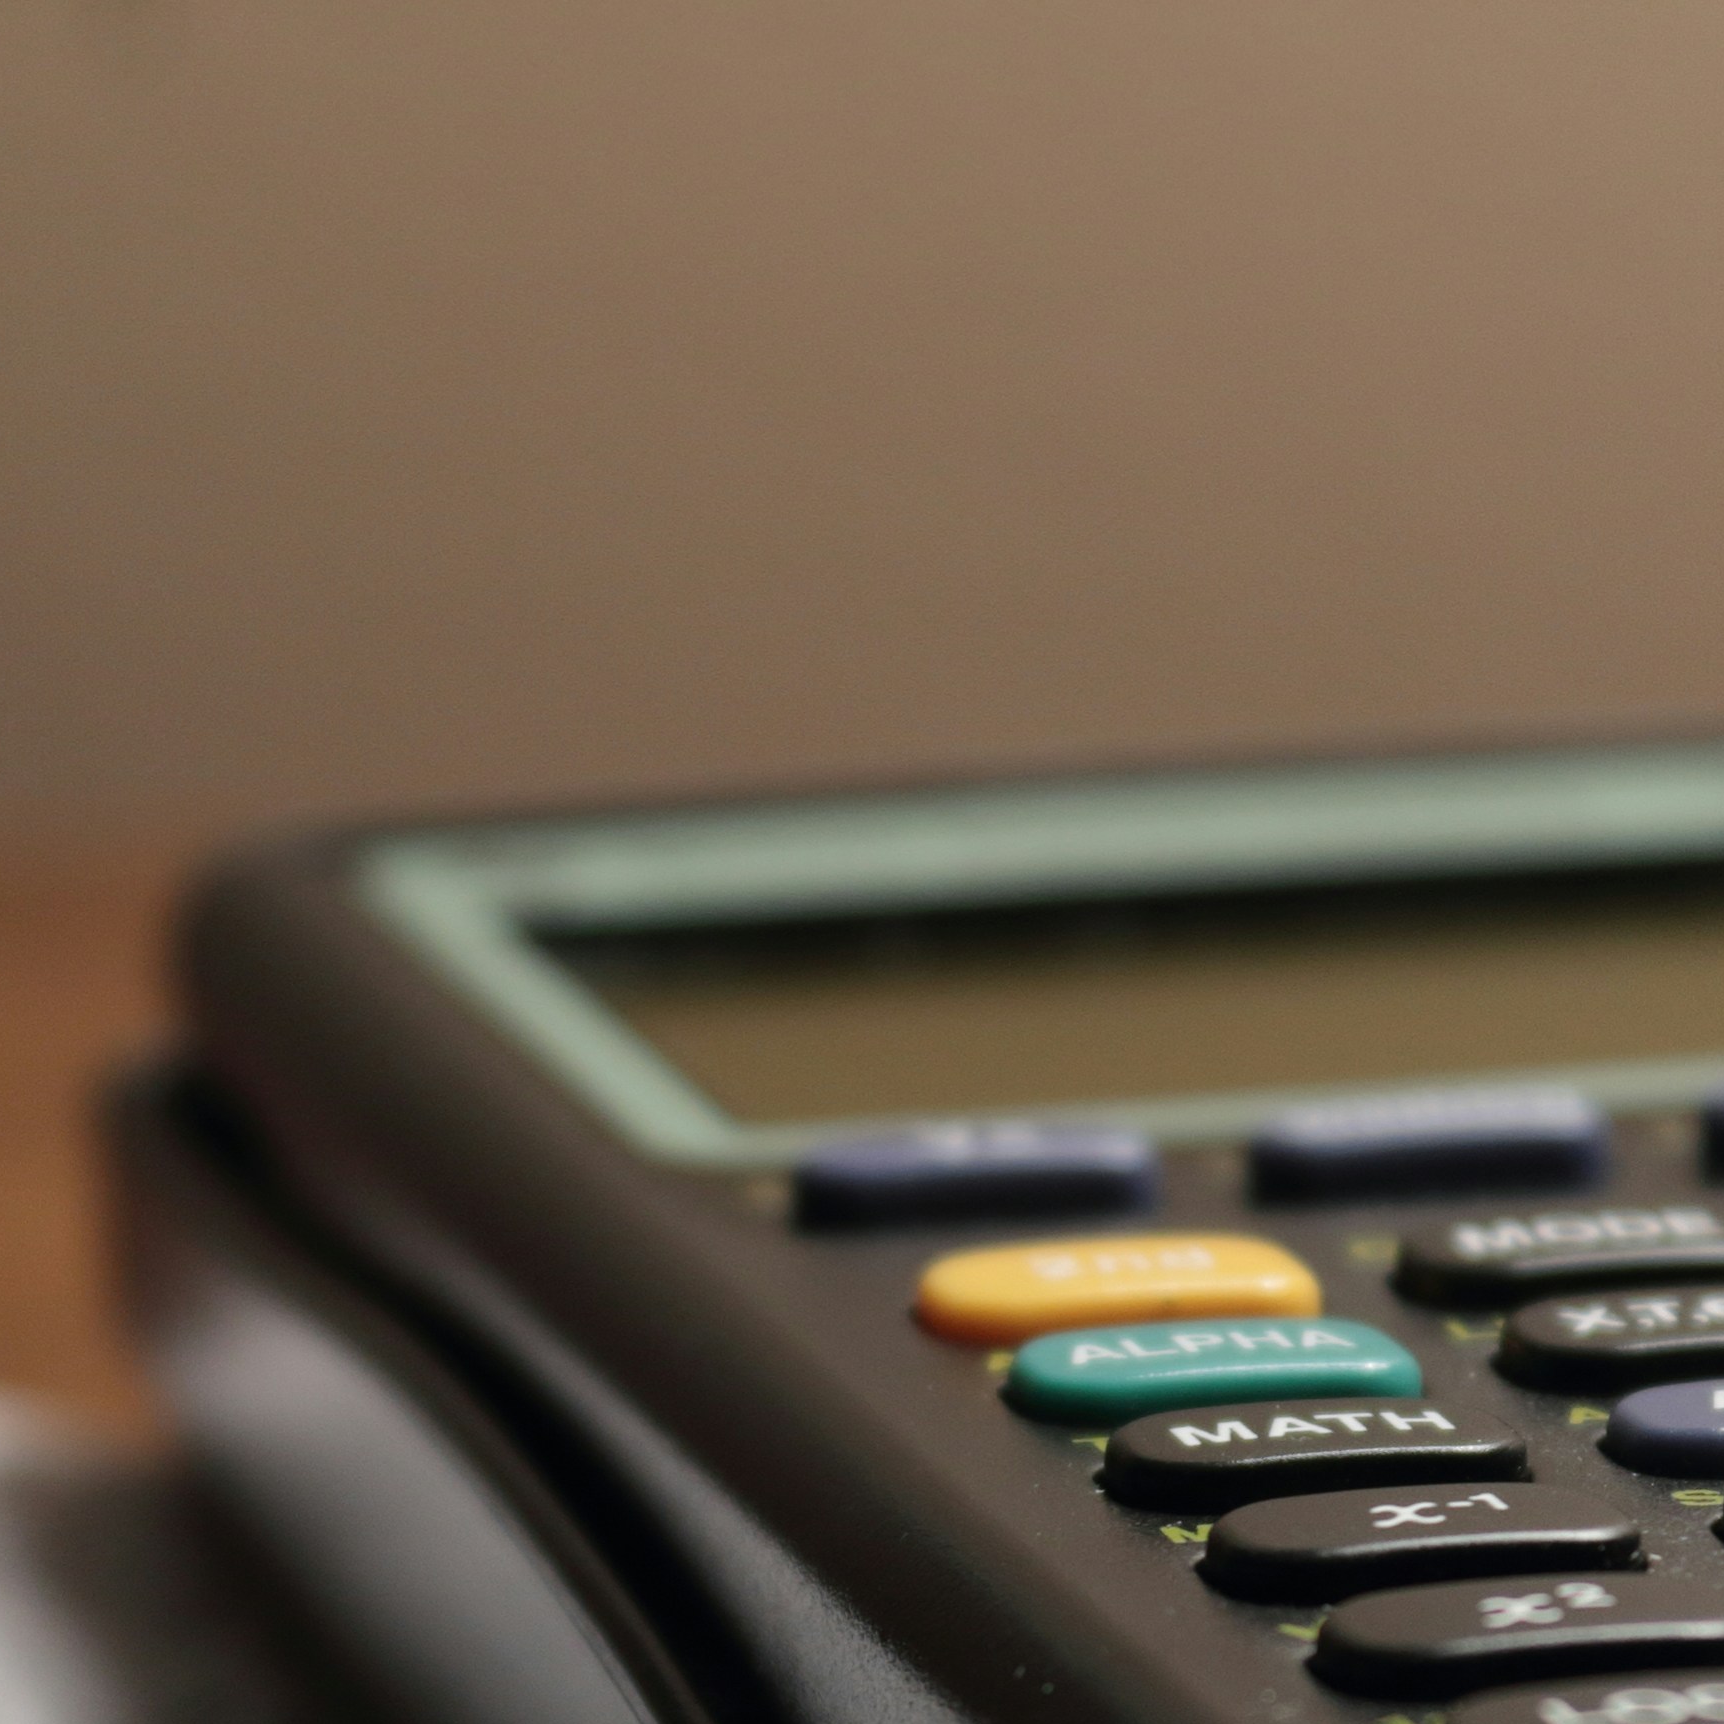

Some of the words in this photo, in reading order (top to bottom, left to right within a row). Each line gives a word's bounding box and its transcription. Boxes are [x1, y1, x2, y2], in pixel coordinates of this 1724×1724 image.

[1453, 1206, 1724, 1257] MODE
[1071, 1326, 1357, 1366] ALPHA
[1168, 1410, 1458, 1448] MATH
